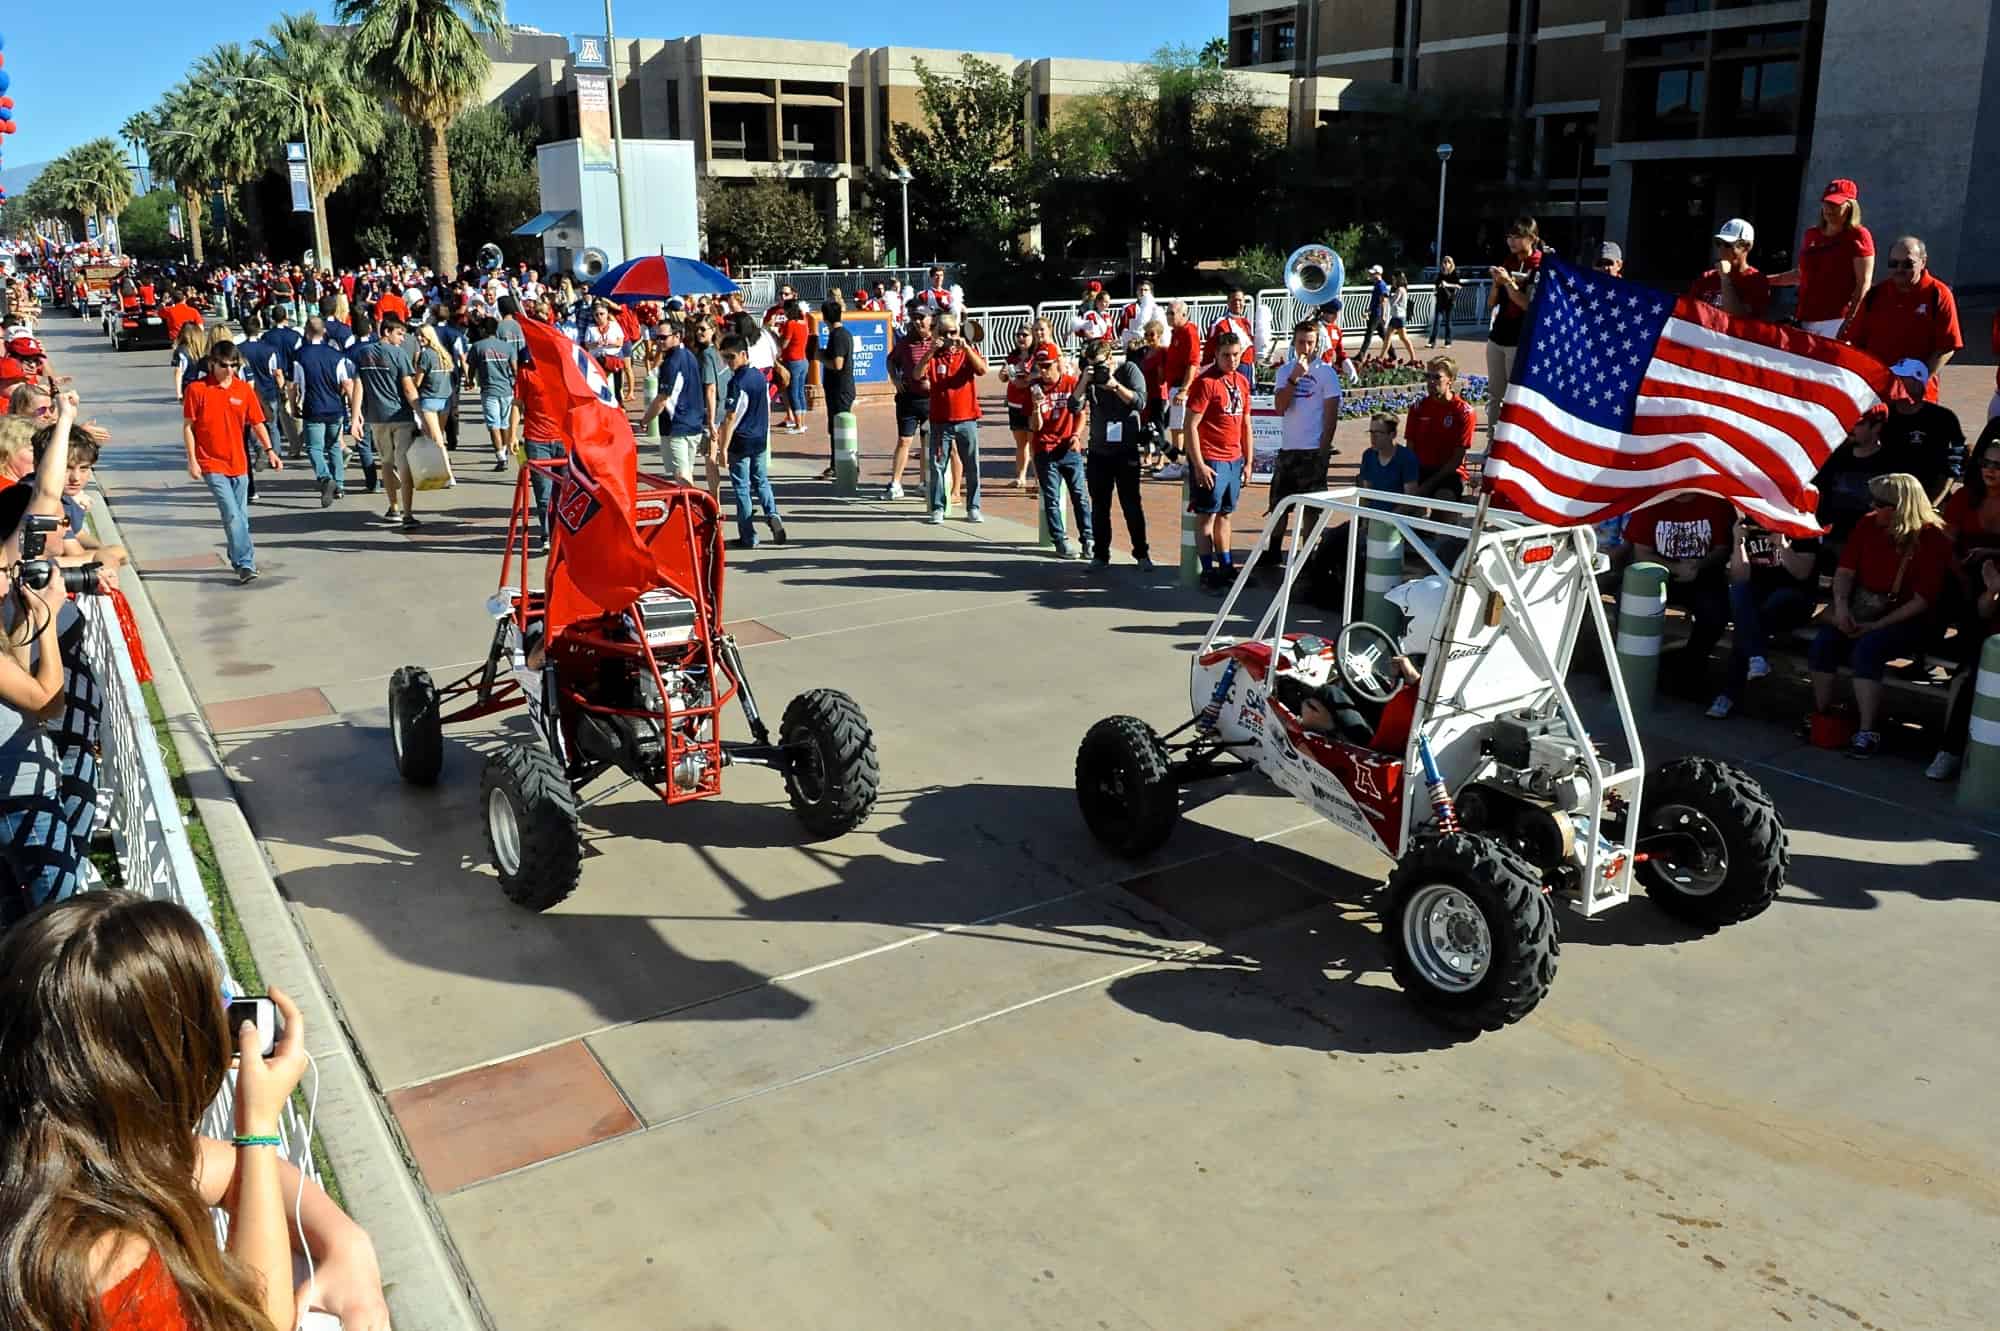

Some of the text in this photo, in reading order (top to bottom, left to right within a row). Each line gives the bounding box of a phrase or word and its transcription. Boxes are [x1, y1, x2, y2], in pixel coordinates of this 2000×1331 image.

[579, 39, 602, 62] A
[862, 343, 884, 352] CHECO
[1349, 752, 1383, 800] A
